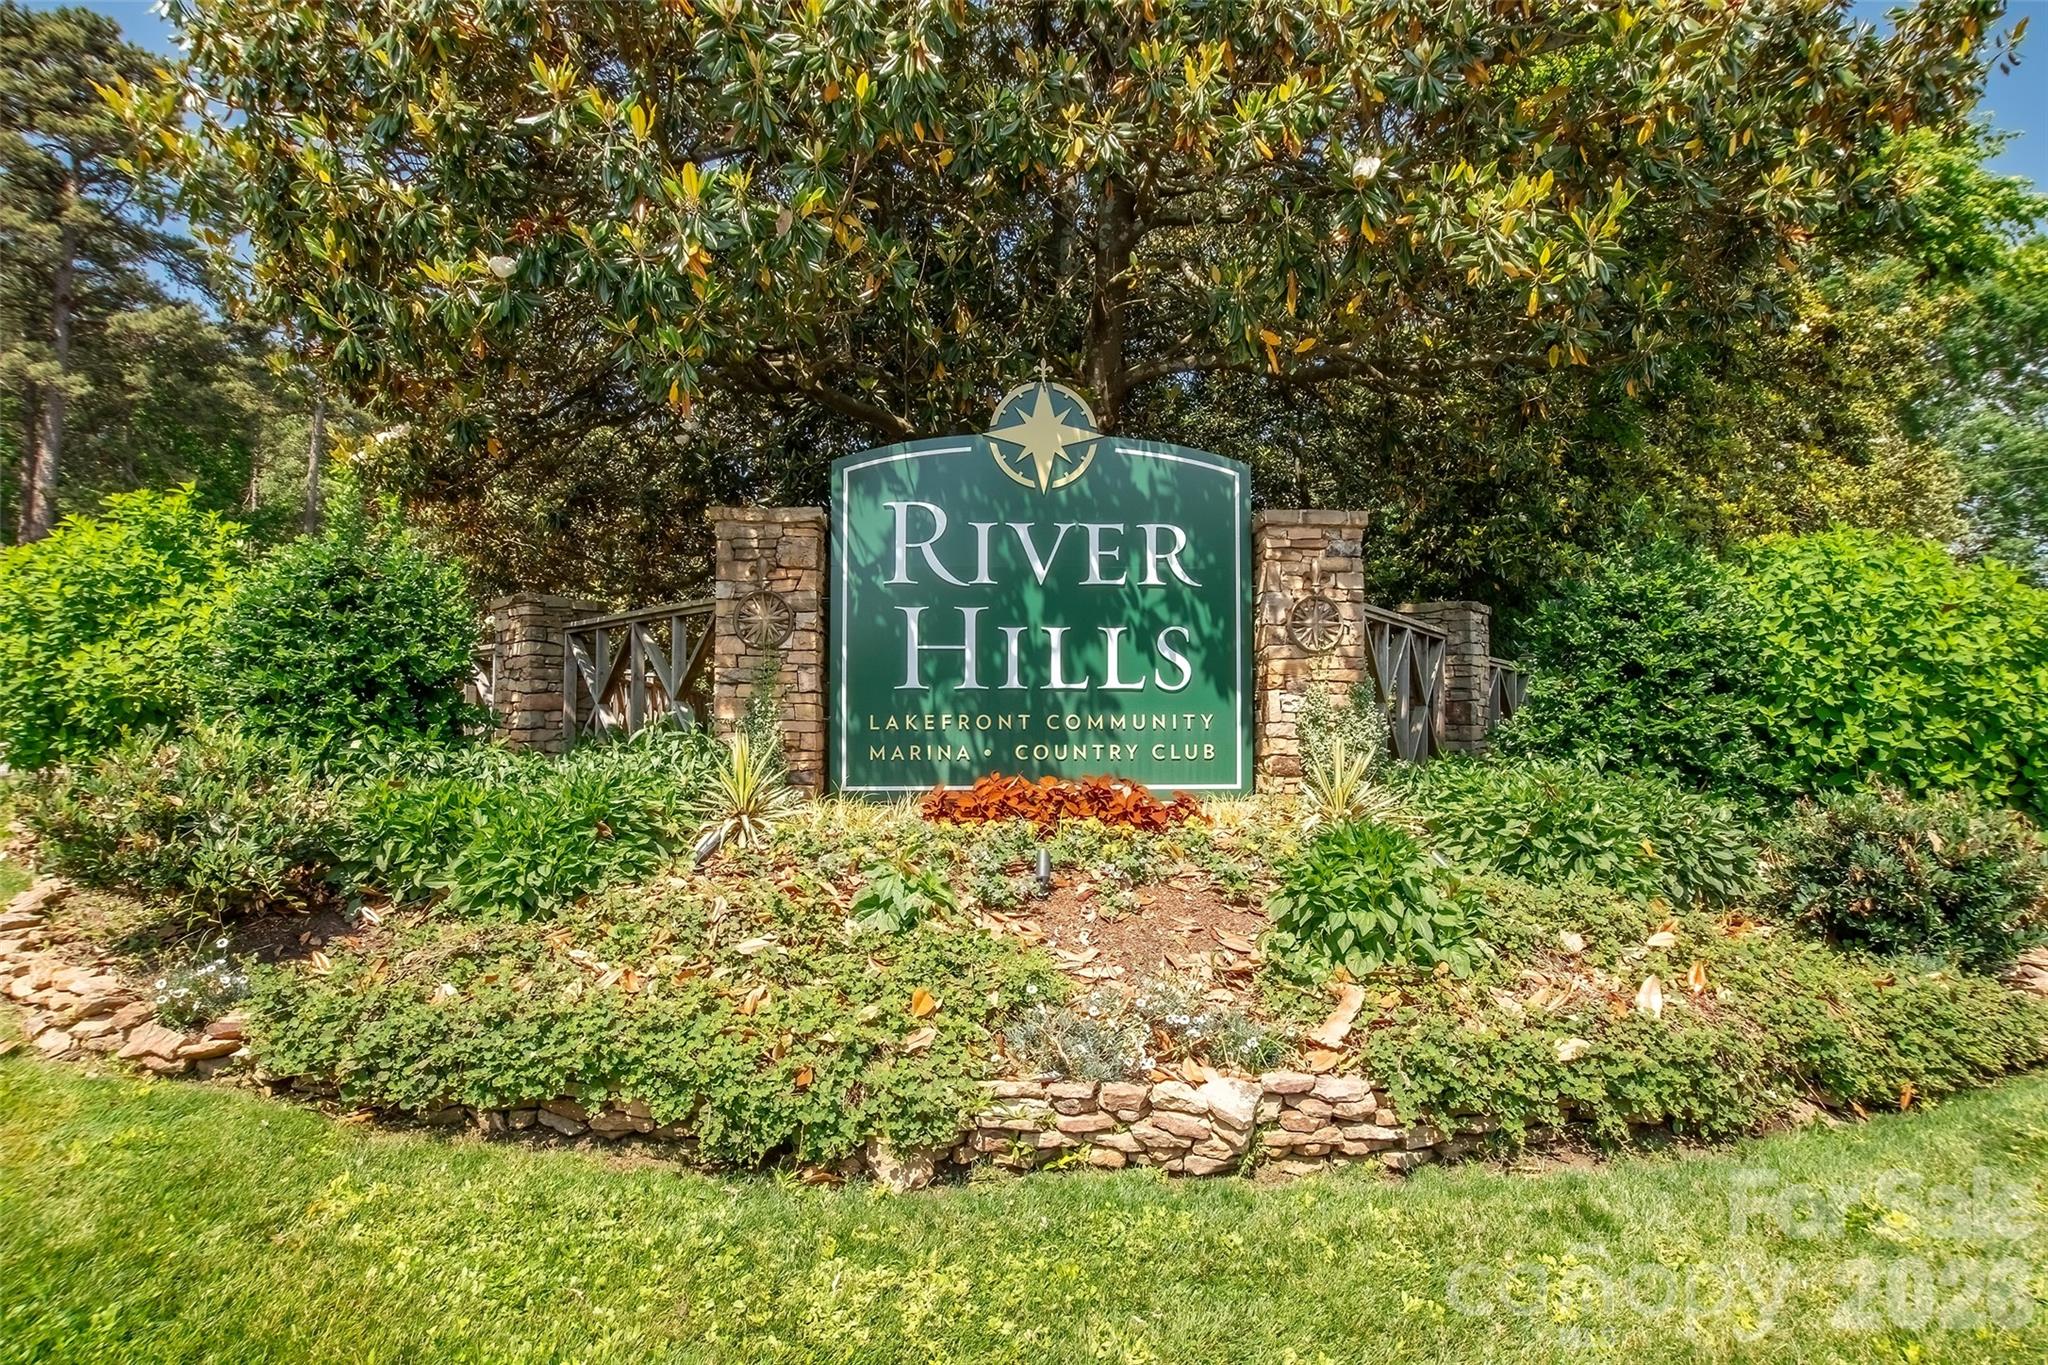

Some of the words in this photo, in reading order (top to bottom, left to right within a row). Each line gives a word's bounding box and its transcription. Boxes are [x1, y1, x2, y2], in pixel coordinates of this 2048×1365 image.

[883, 501, 1202, 586] RIVER
[893, 606, 1193, 691] HILLS
[869, 714, 1031, 730] LAKEFRONT
[1046, 713, 1215, 731] COMMUNITY
[869, 743, 971, 761] MARINA
[1015, 743, 1140, 761] COUNTRY
[1151, 743, 1216, 760] CLUB
